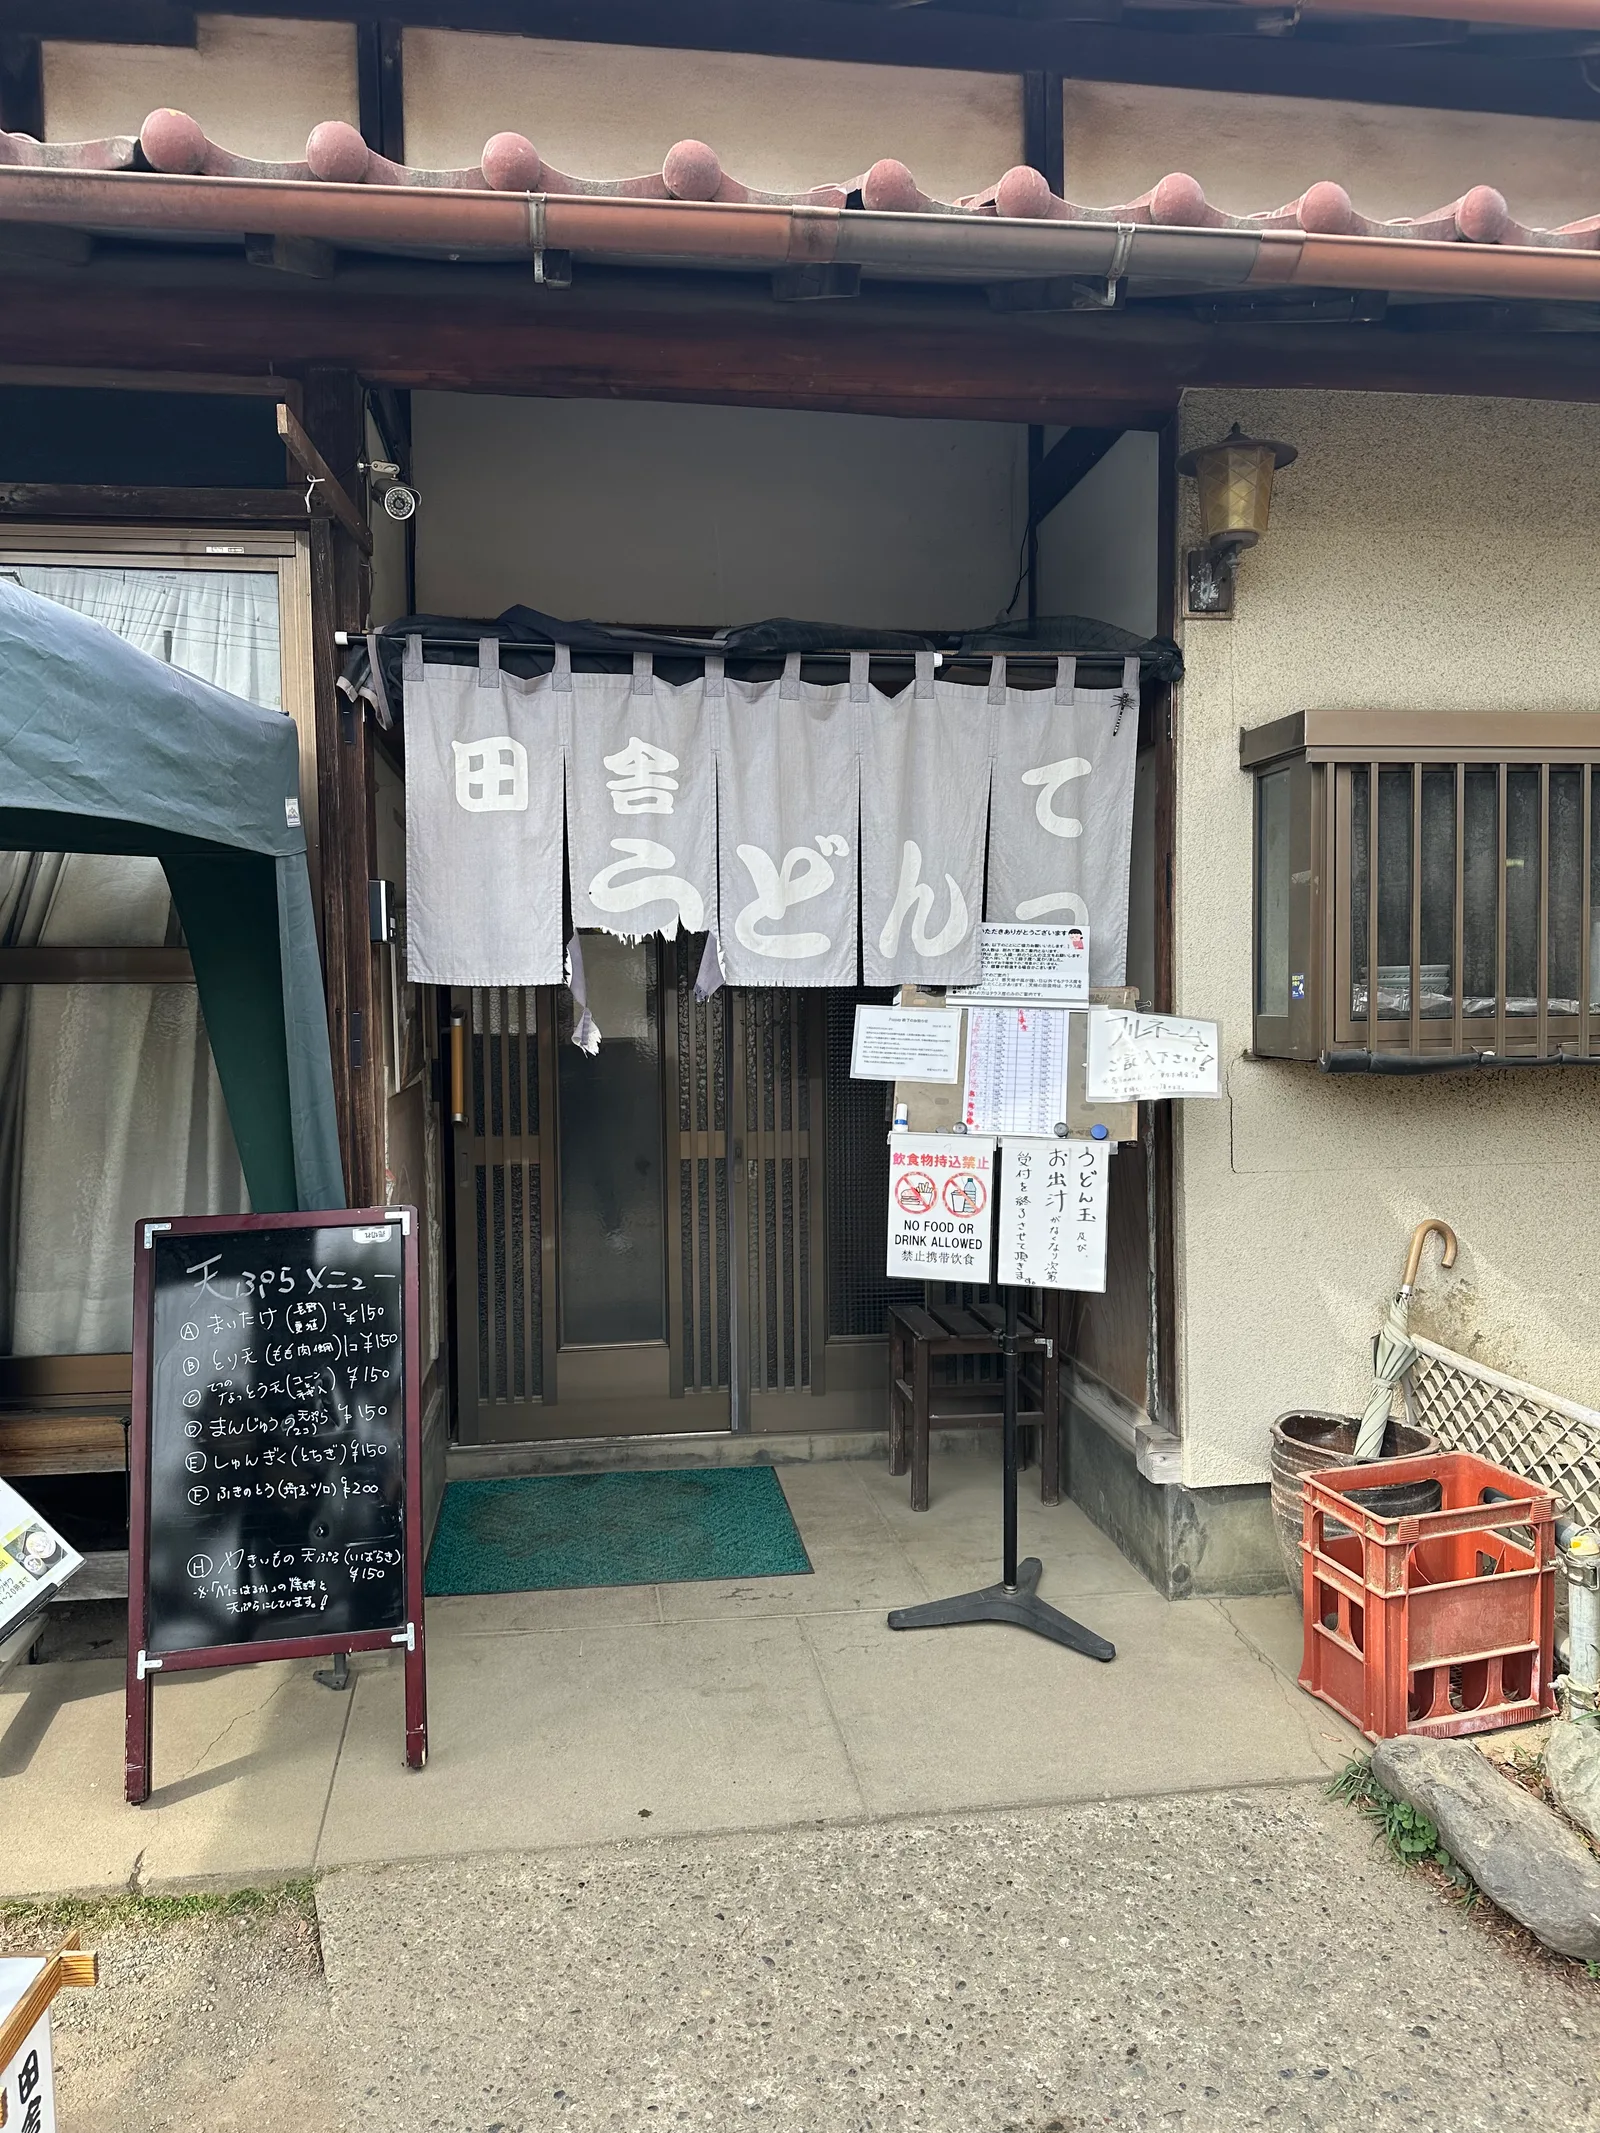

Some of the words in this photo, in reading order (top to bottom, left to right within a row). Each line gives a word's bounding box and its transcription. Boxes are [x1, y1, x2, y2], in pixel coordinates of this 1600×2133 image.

[451, 734, 680, 815] 田舎
[588, 834, 971, 961] うどん
[892, 1152, 990, 1170] 飲食物持込禁止
[904, 1220, 920, 1231] NO
[924, 1220, 954, 1233] FOOD
[959, 1222, 974, 1234] OR
[894, 1234, 927, 1247] DRINK
[931, 1235, 983, 1250] ALLOWED
